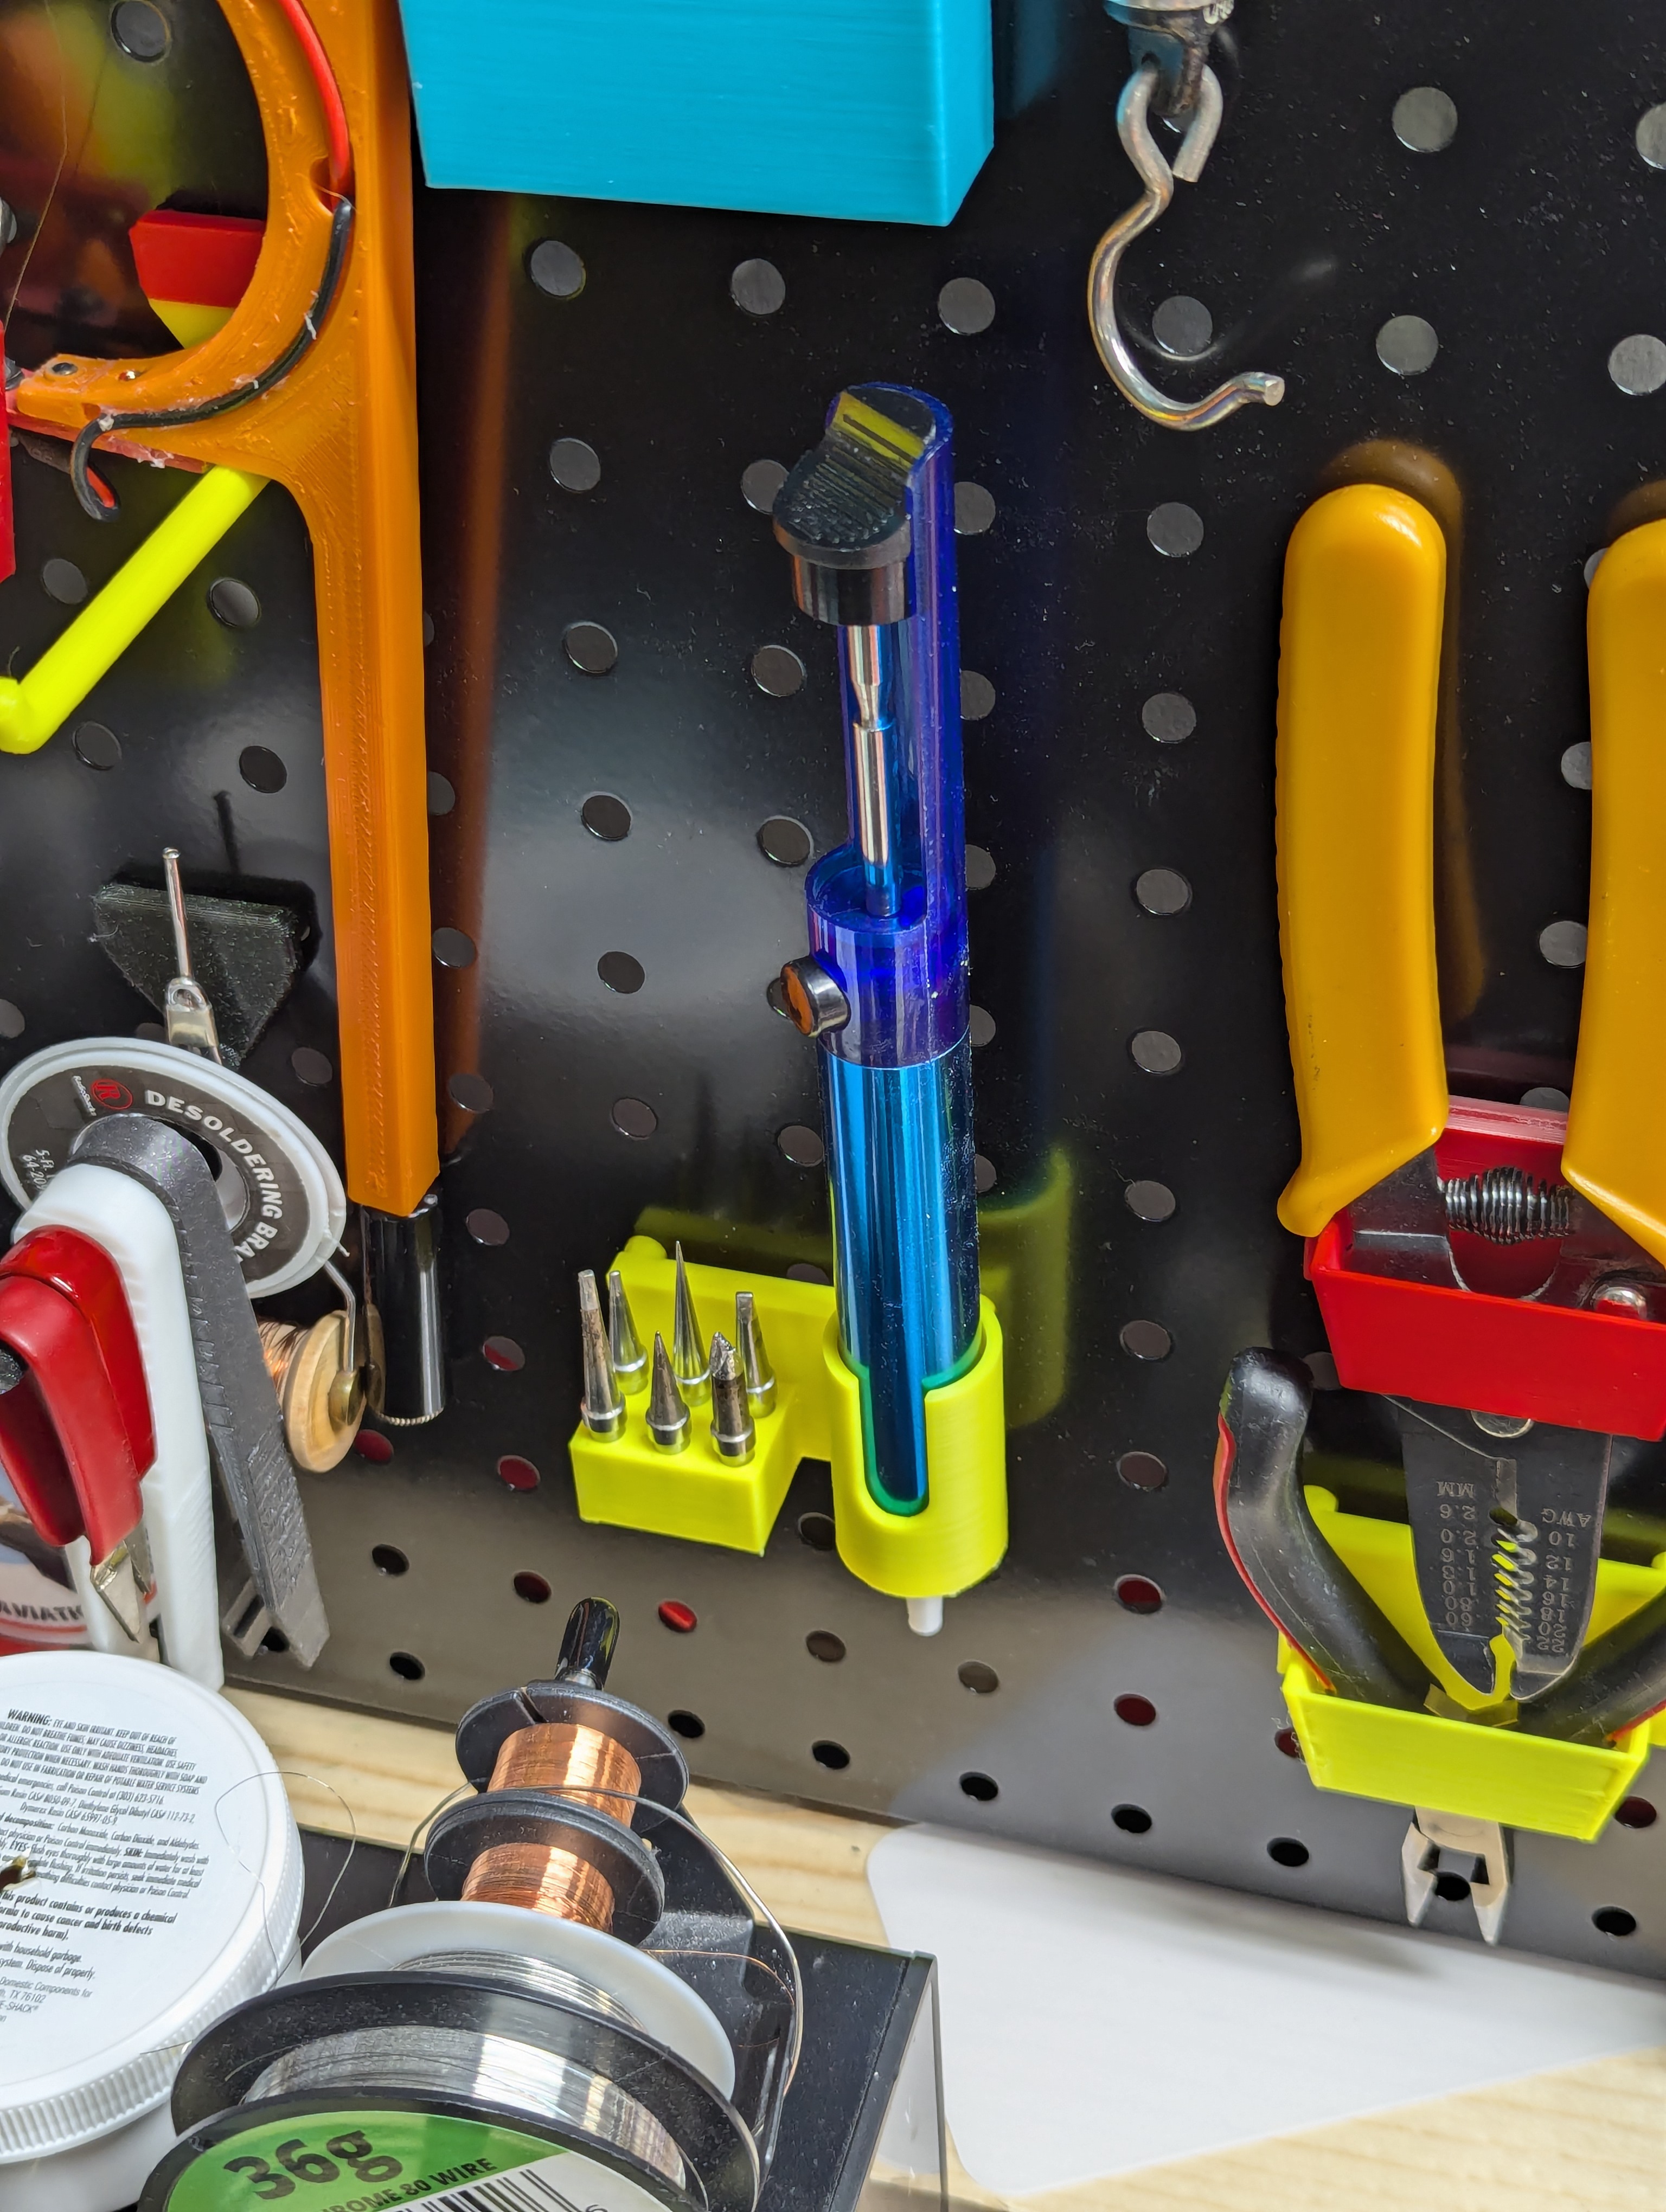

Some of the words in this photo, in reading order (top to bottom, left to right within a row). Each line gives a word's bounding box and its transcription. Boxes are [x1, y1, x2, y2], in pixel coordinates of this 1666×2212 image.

[145, 1089, 283, 1220] DESOLDERING
[1437, 1481, 1475, 1499] MM
[1439, 1503, 1476, 1520] 2.6
[1541, 1507, 1592, 1528] AWG
[1440, 1529, 1477, 1545] 2.0
[1548, 1532, 1575, 1548] 10
[1546, 1554, 1572, 1571] 12
[1543, 1575, 1569, 1591] 14
[1542, 1592, 1569, 1608] 16
[1538, 1622, 1567, 1639] 20
[8, 1709, 52, 1726] WARNING:
[14, 1893, 49, 1908] product
[49, 1901, 84, 1913] contains
[85, 1906, 95, 1914] or
[93, 1905, 133, 1919] produces
[133, 1911, 139, 1919] a
[141, 1909, 178, 1924] chemical
[21, 1908, 30, 1918] to
[31, 1912, 55, 1922] cause
[56, 1917, 84, 1927] cancer
[84, 1918, 102, 1929] and
[100, 1918, 123, 1932] birth
[123, 1922, 153, 1936] defects
[13, 1941, 54, 1958] household
[25, 1959, 54, 1973] Dispose
[9, 1989, 21, 1999] TX
[21, 1992, 46, 2003] 76102
[34, 1982, 81, 1997] Components
[223, 2130, 403, 2201] 36g
[321, 2189, 403, 2212] ROME
[400, 2179, 432, 2196] 80
[428, 2158, 497, 2185] WIRE
